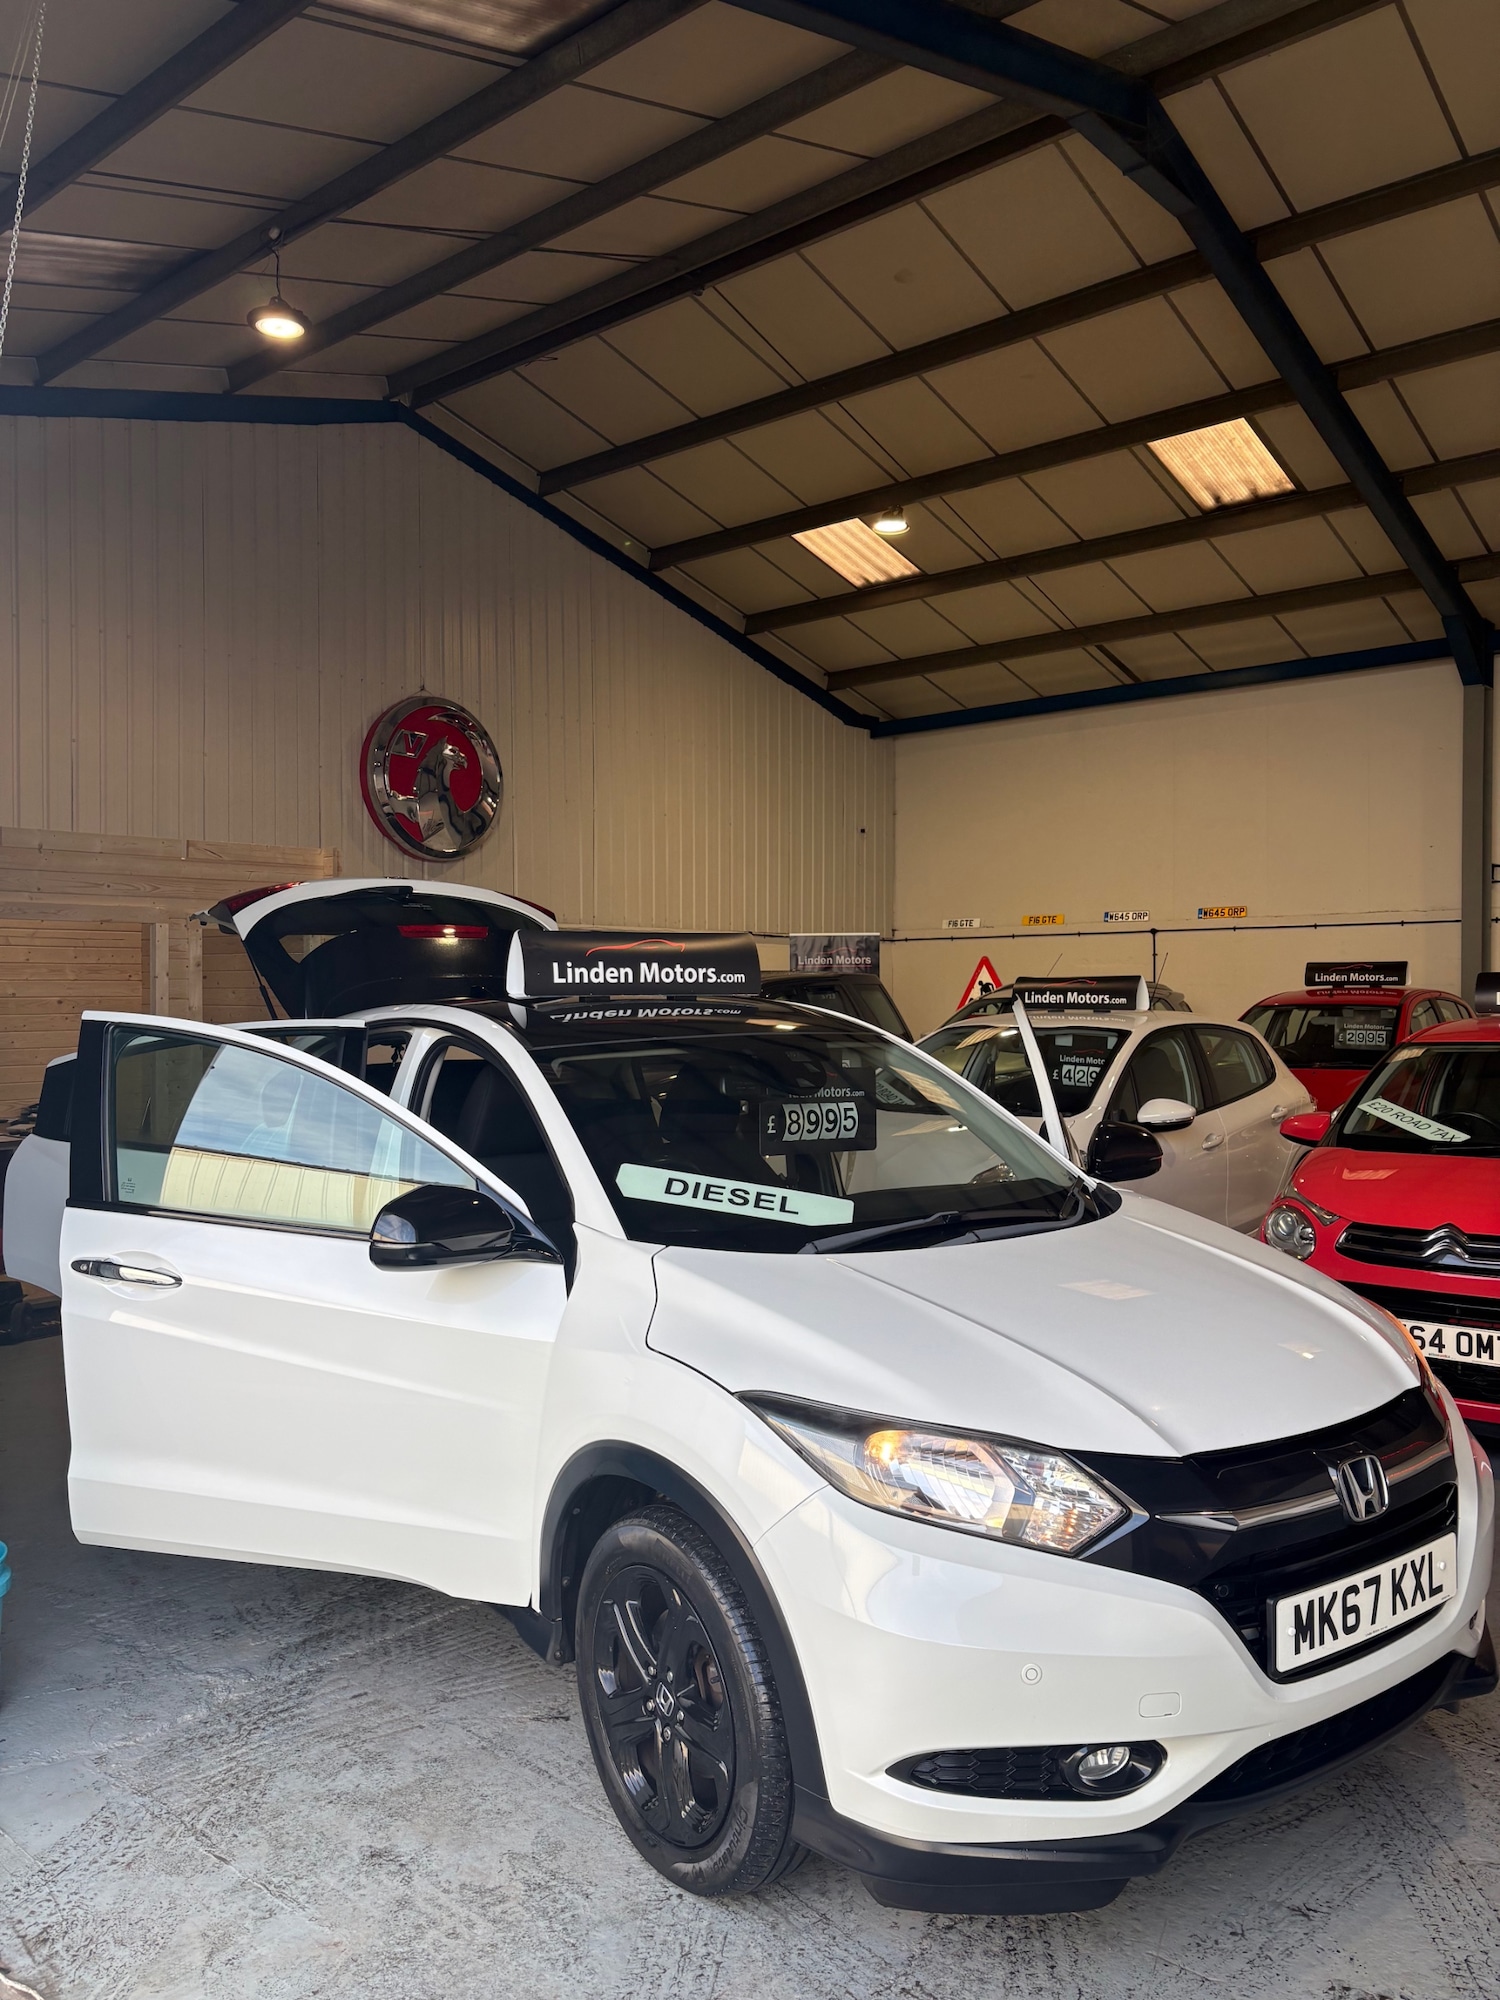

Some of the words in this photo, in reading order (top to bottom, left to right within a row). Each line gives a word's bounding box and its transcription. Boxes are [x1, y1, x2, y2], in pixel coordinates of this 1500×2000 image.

[1109, 912, 1131, 921] W645
[1131, 911, 1148, 920] ORP
[1227, 907, 1245, 916] ORP
[1041, 915, 1057, 924] GTE
[797, 955, 833, 965] Linden
[835, 955, 872, 965] Motors
[552, 961, 633, 984] Linden
[639, 961, 746, 984] Motors.com
[1314, 972, 1348, 982] Linden
[1349, 972, 1399, 982] Motors.com
[1024, 991, 1064, 1004] Linden
[1066, 991, 1127, 1004] Motors.com
[1059, 1054, 1085, 1064] Linden
[1366, 1101, 1394, 1114] £20
[1390, 1111, 1431, 1131] ROAD
[1430, 1127, 1462, 1142] TAX
[663, 1177, 799, 1216] DIESEL
[1455, 1331, 1500, 1361] OM
[1293, 1573, 1382, 1656] MK67
[1390, 1550, 1444, 1617] KXL
